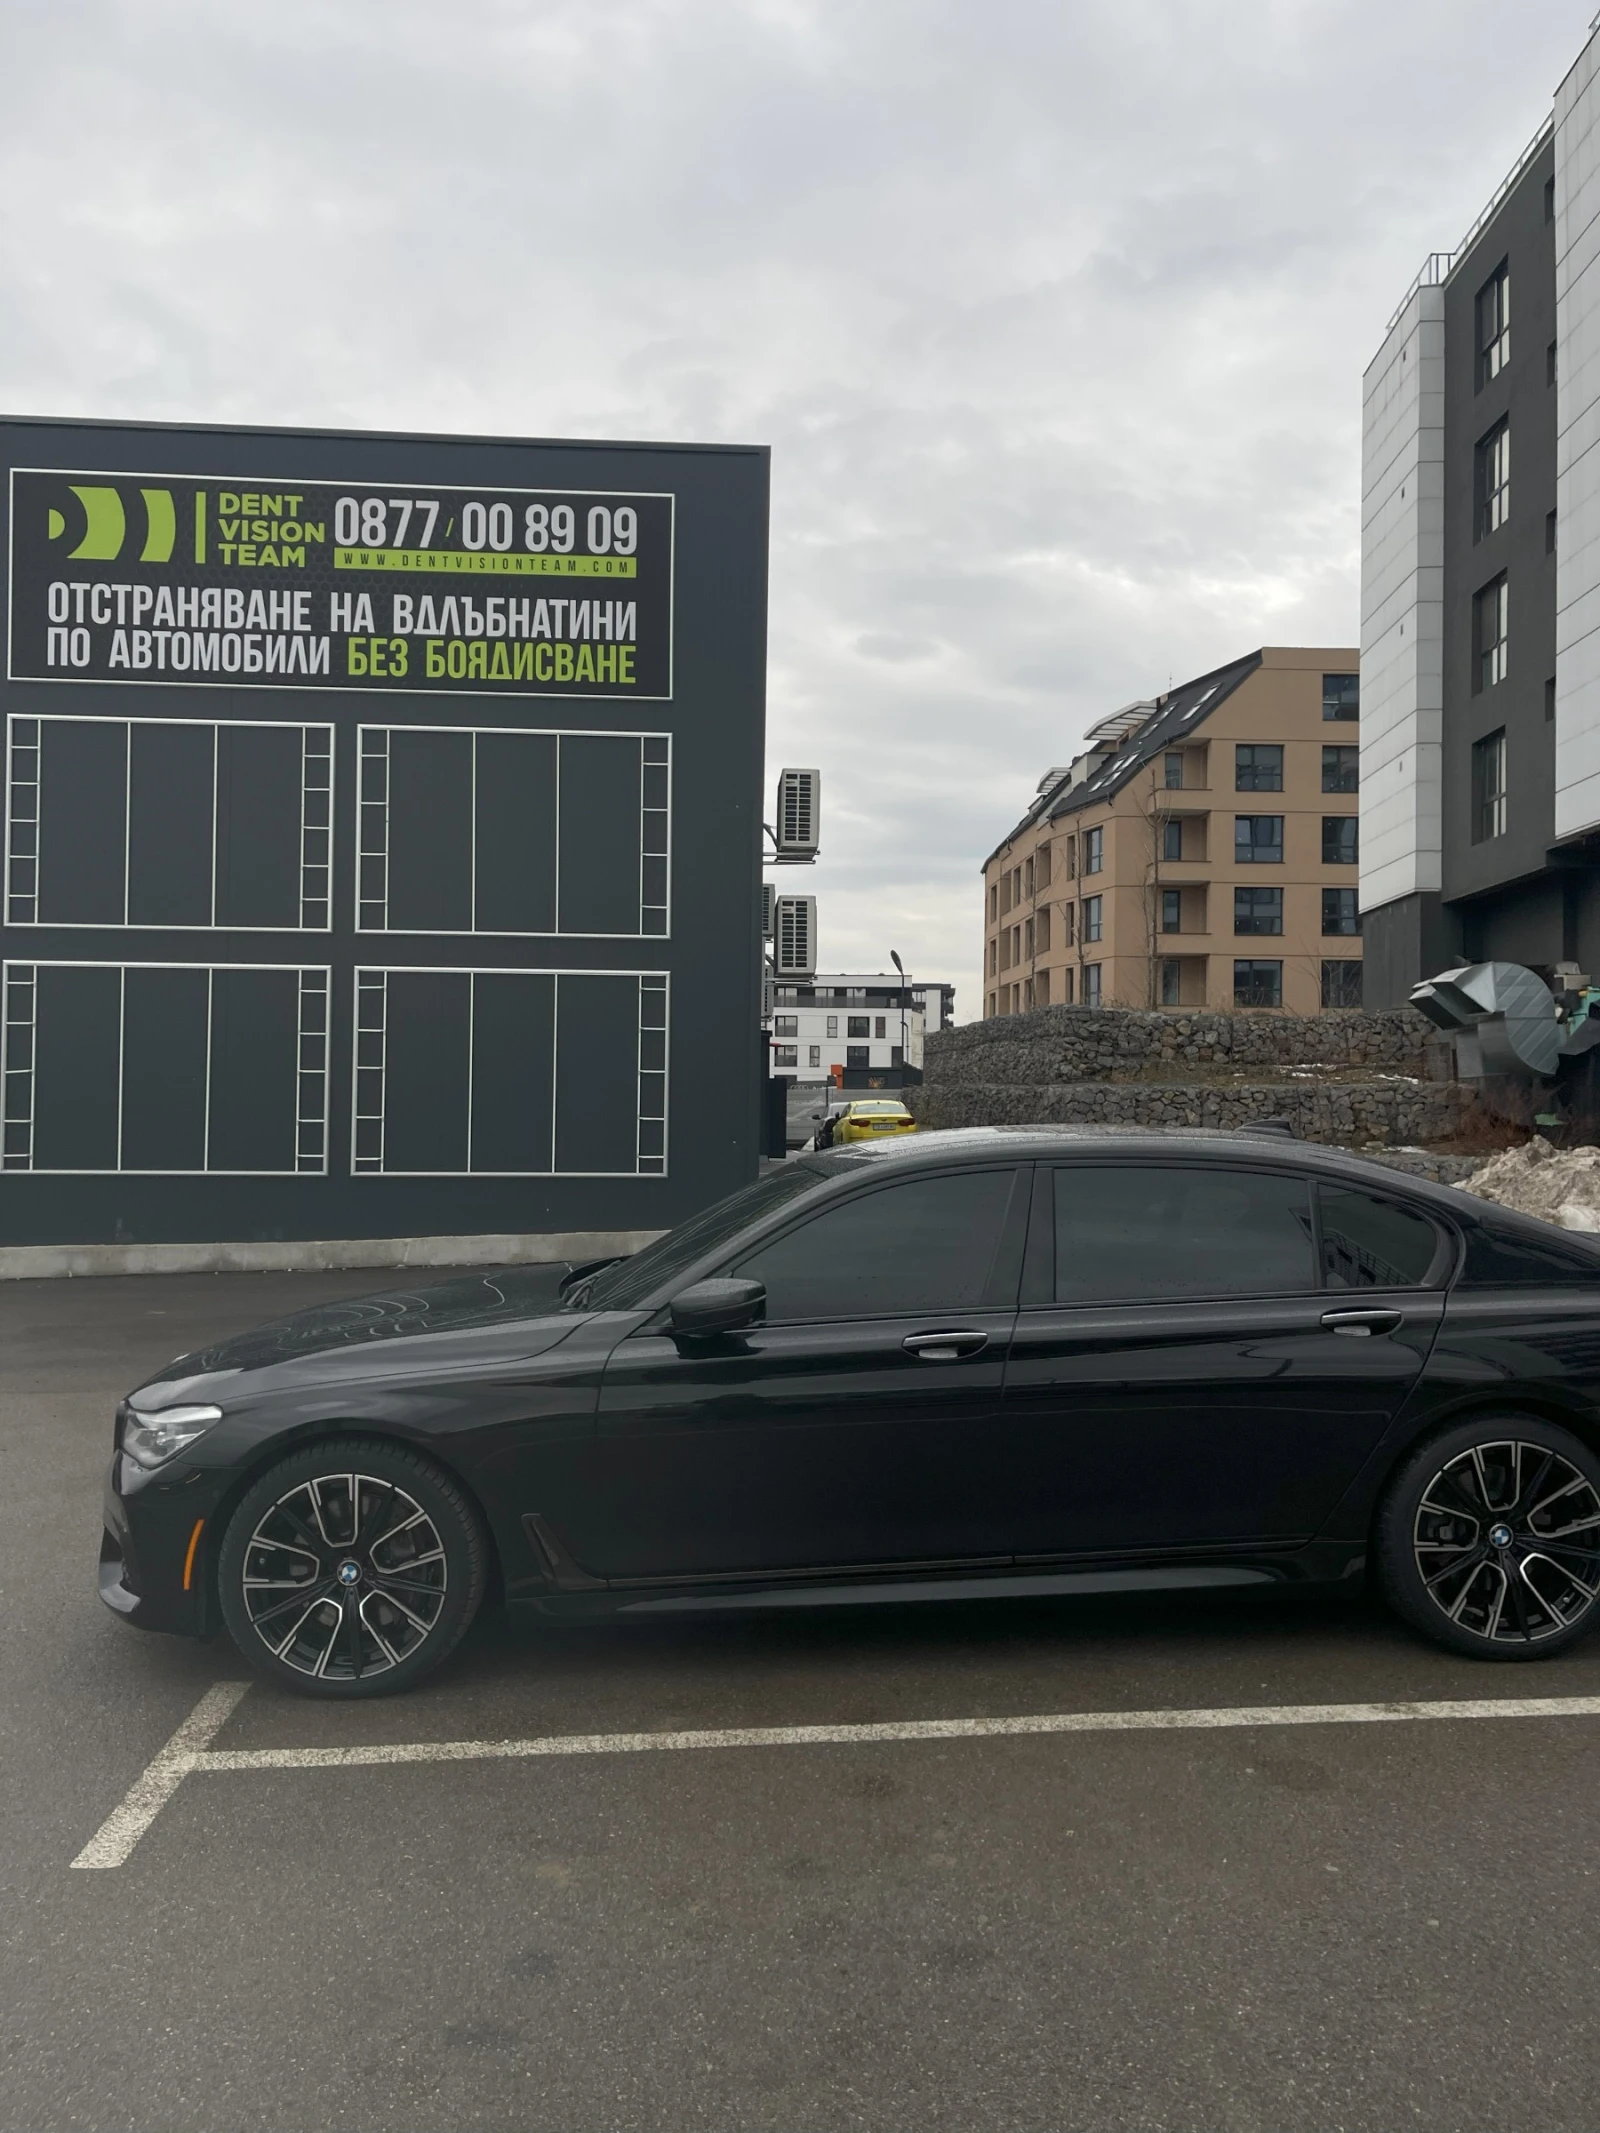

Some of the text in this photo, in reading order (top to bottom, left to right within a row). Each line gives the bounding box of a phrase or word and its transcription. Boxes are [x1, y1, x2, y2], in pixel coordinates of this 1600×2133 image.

[218, 492, 304, 517] DENT
[218, 518, 325, 543] VISION
[334, 497, 440, 548] 0877
[462, 502, 512, 551] 00
[525, 503, 575, 553] 89
[587, 506, 637, 555] 09
[218, 543, 305, 568] TEAM
[48, 581, 636, 641] ОТСТРАНЯВАНЕ НА ВДЛЪБНАТИНИ
[48, 627, 636, 683] ПО АВТОМОБИЛИ БЕЗ БОЯДИСВАНЕ
